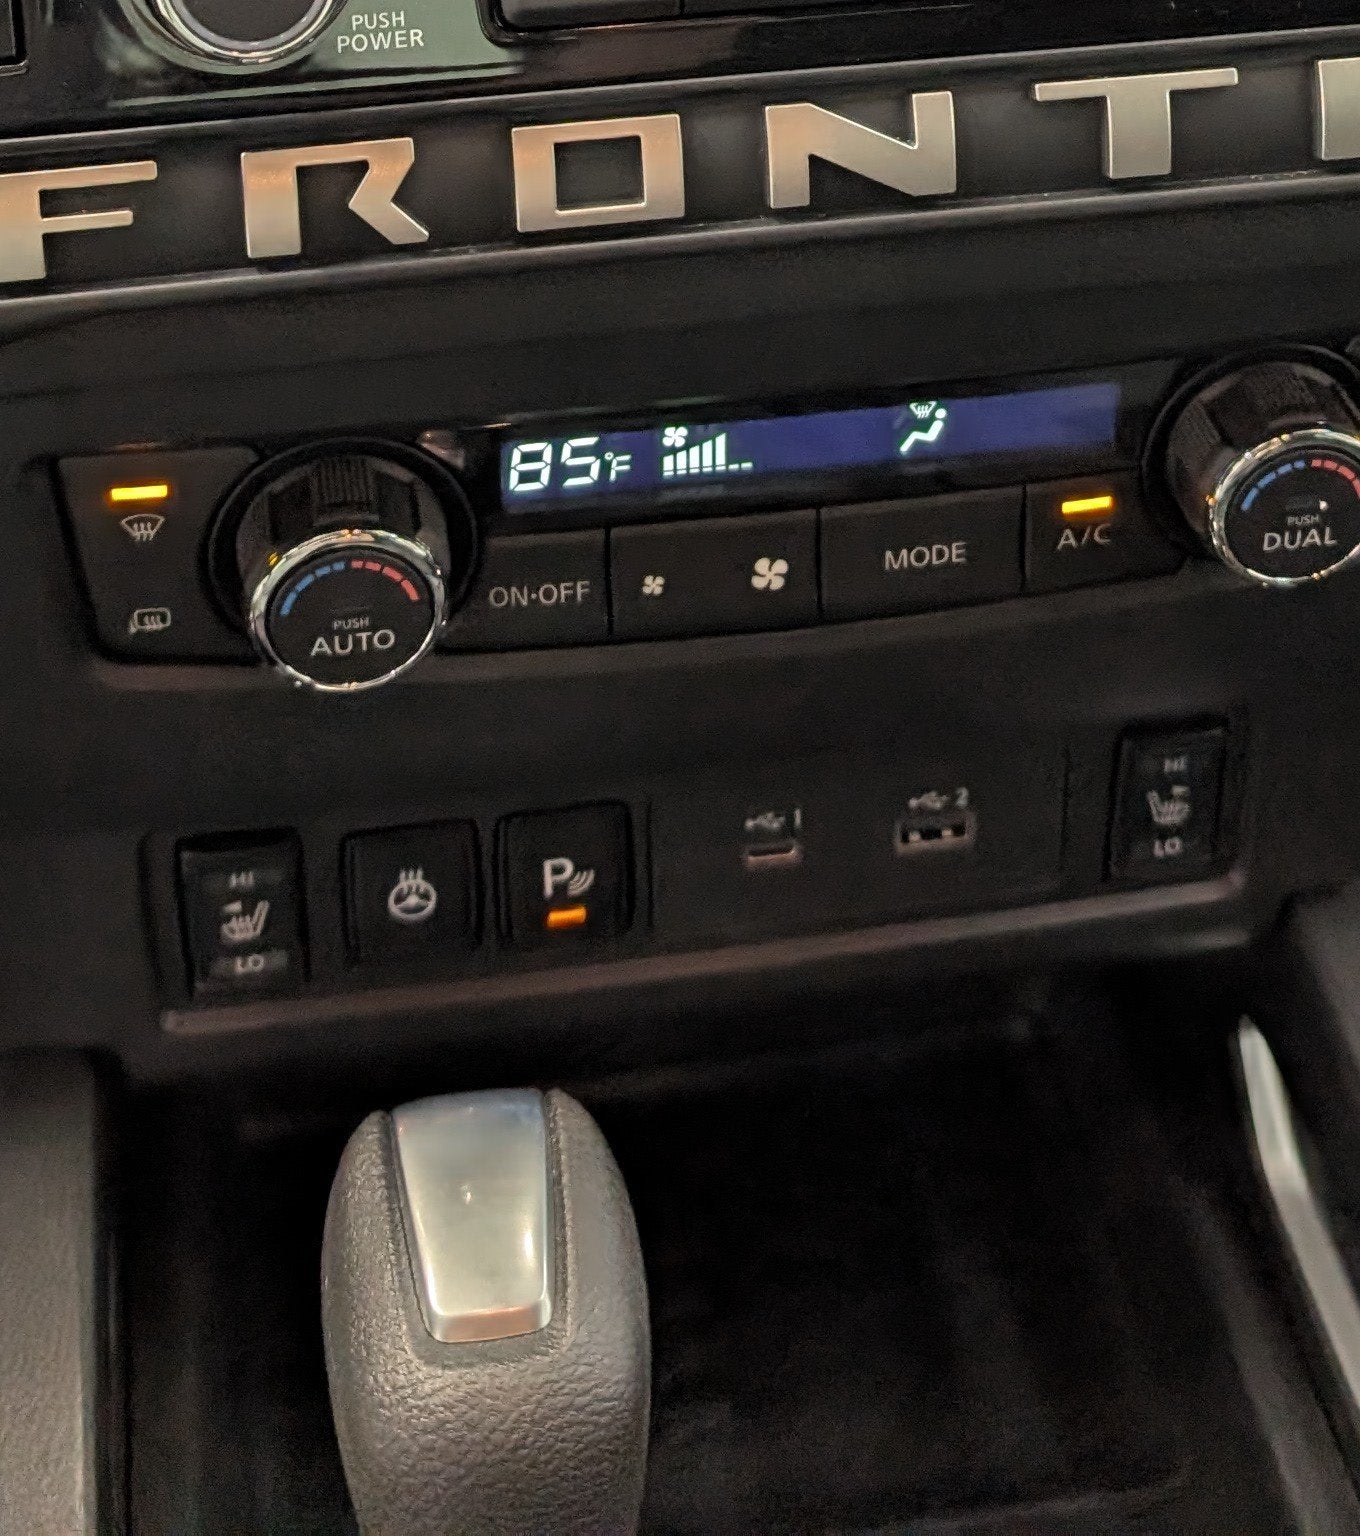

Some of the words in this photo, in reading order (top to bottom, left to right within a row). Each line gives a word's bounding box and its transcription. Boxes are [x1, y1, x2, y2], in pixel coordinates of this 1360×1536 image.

[351, 11, 405, 31] PUSH
[337, 29, 423, 53] POWER
[1287, 514, 1321, 526] PUSH
[1057, 523, 1111, 550] A/C
[1262, 527, 1338, 551] DUAL
[884, 541, 966, 570] MODE
[311, 629, 395, 655] AUTO
